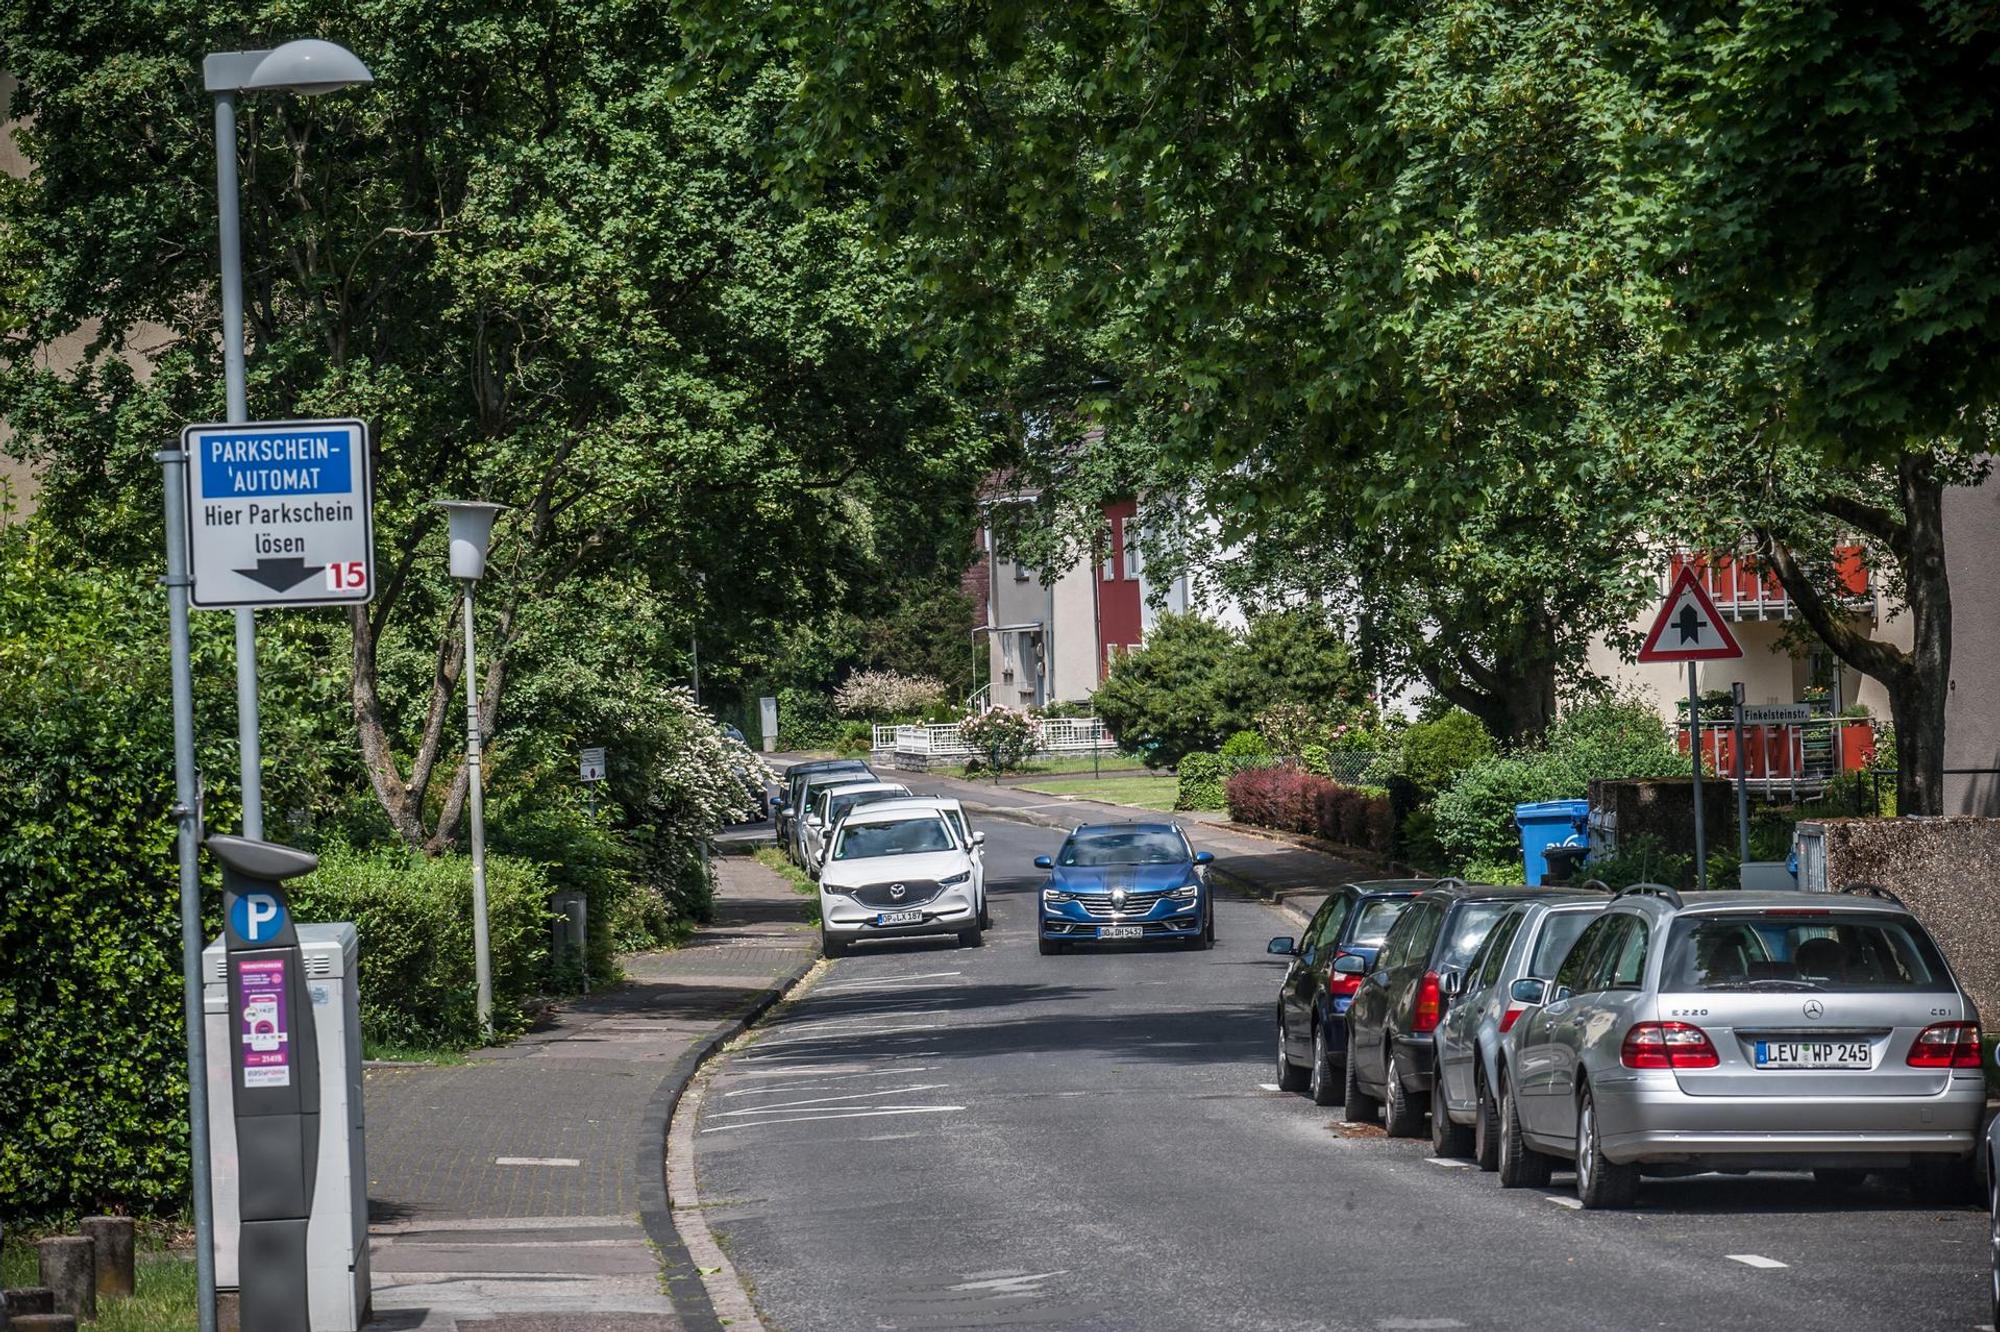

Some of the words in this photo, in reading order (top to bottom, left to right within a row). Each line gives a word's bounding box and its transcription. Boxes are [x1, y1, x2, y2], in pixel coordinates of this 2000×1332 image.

[212, 438, 340, 463] PARKSCHEIN-
[234, 468, 320, 492] AUTOMAT
[205, 505, 243, 526] Hier
[249, 500, 353, 525] Parkschein
[255, 533, 305, 554] lösen
[330, 562, 366, 588] 15
[1744, 708, 1808, 720] Finkelsteinstr.
[247, 893, 277, 940] P
[1930, 1008, 1952, 1016] CDI
[1767, 1044, 1799, 1062] LEV
[1812, 1044, 1833, 1062] WP
[1838, 1044, 1868, 1062] 245
